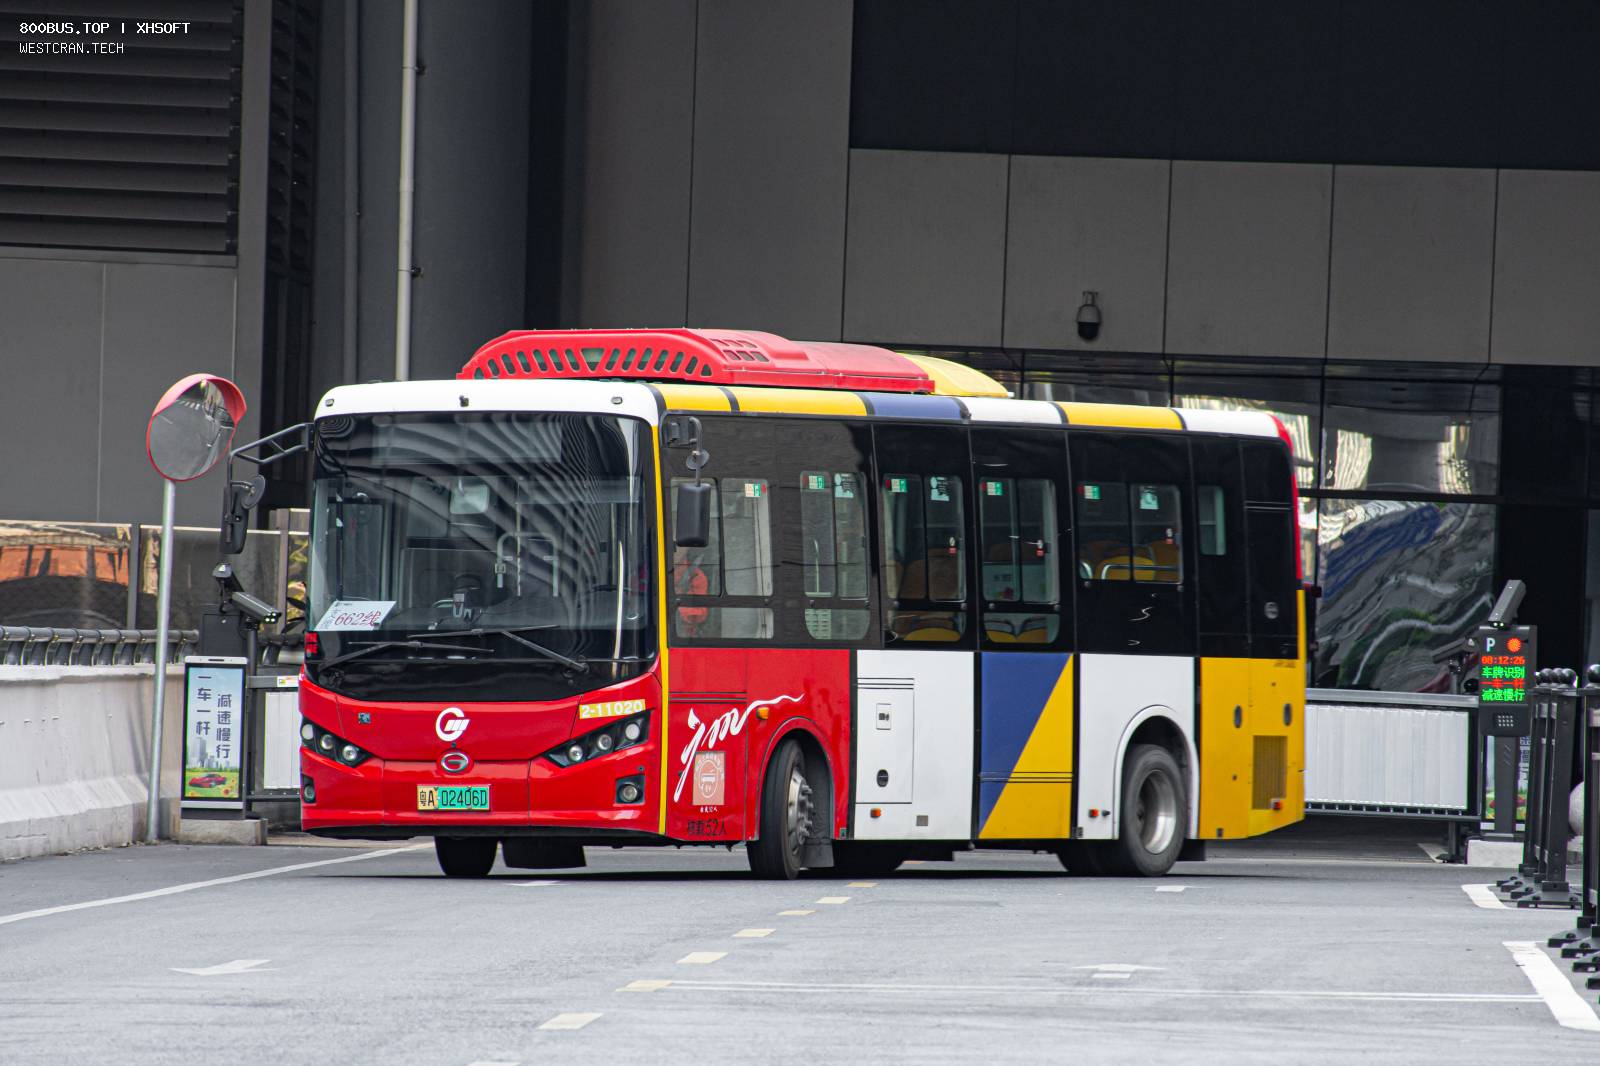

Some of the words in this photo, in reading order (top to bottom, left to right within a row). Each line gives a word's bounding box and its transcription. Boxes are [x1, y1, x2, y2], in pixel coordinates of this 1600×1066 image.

[1486, 637, 1496, 652] P
[1481, 666, 1526, 679] 车牌识别
[1481, 688, 1526, 702] 减速慢行
[196, 674, 213, 736] 一车一杆
[581, 700, 644, 719] 2-11020
[215, 693, 233, 759] 减速慢行
